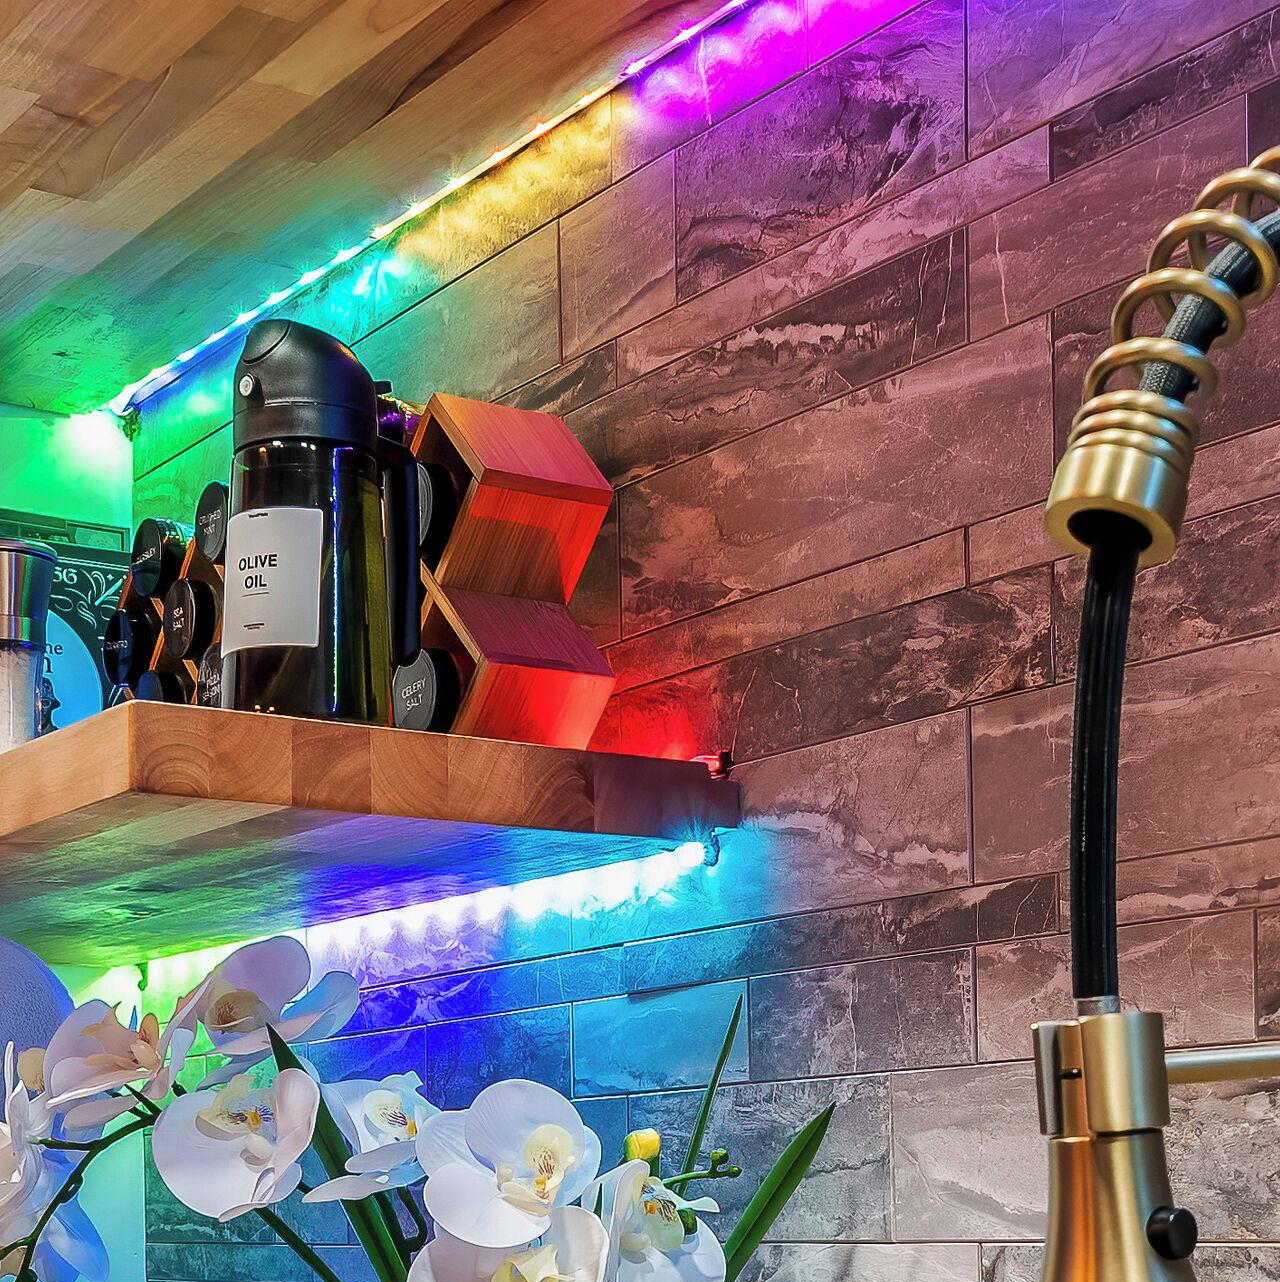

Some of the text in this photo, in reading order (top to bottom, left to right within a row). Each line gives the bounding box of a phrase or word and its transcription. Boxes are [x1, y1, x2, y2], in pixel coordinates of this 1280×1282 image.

[238, 553, 278, 571] OLIVE
[244, 574, 267, 589] OIL
[401, 677, 426, 699] CELERY
[406, 693, 423, 711] SALT
